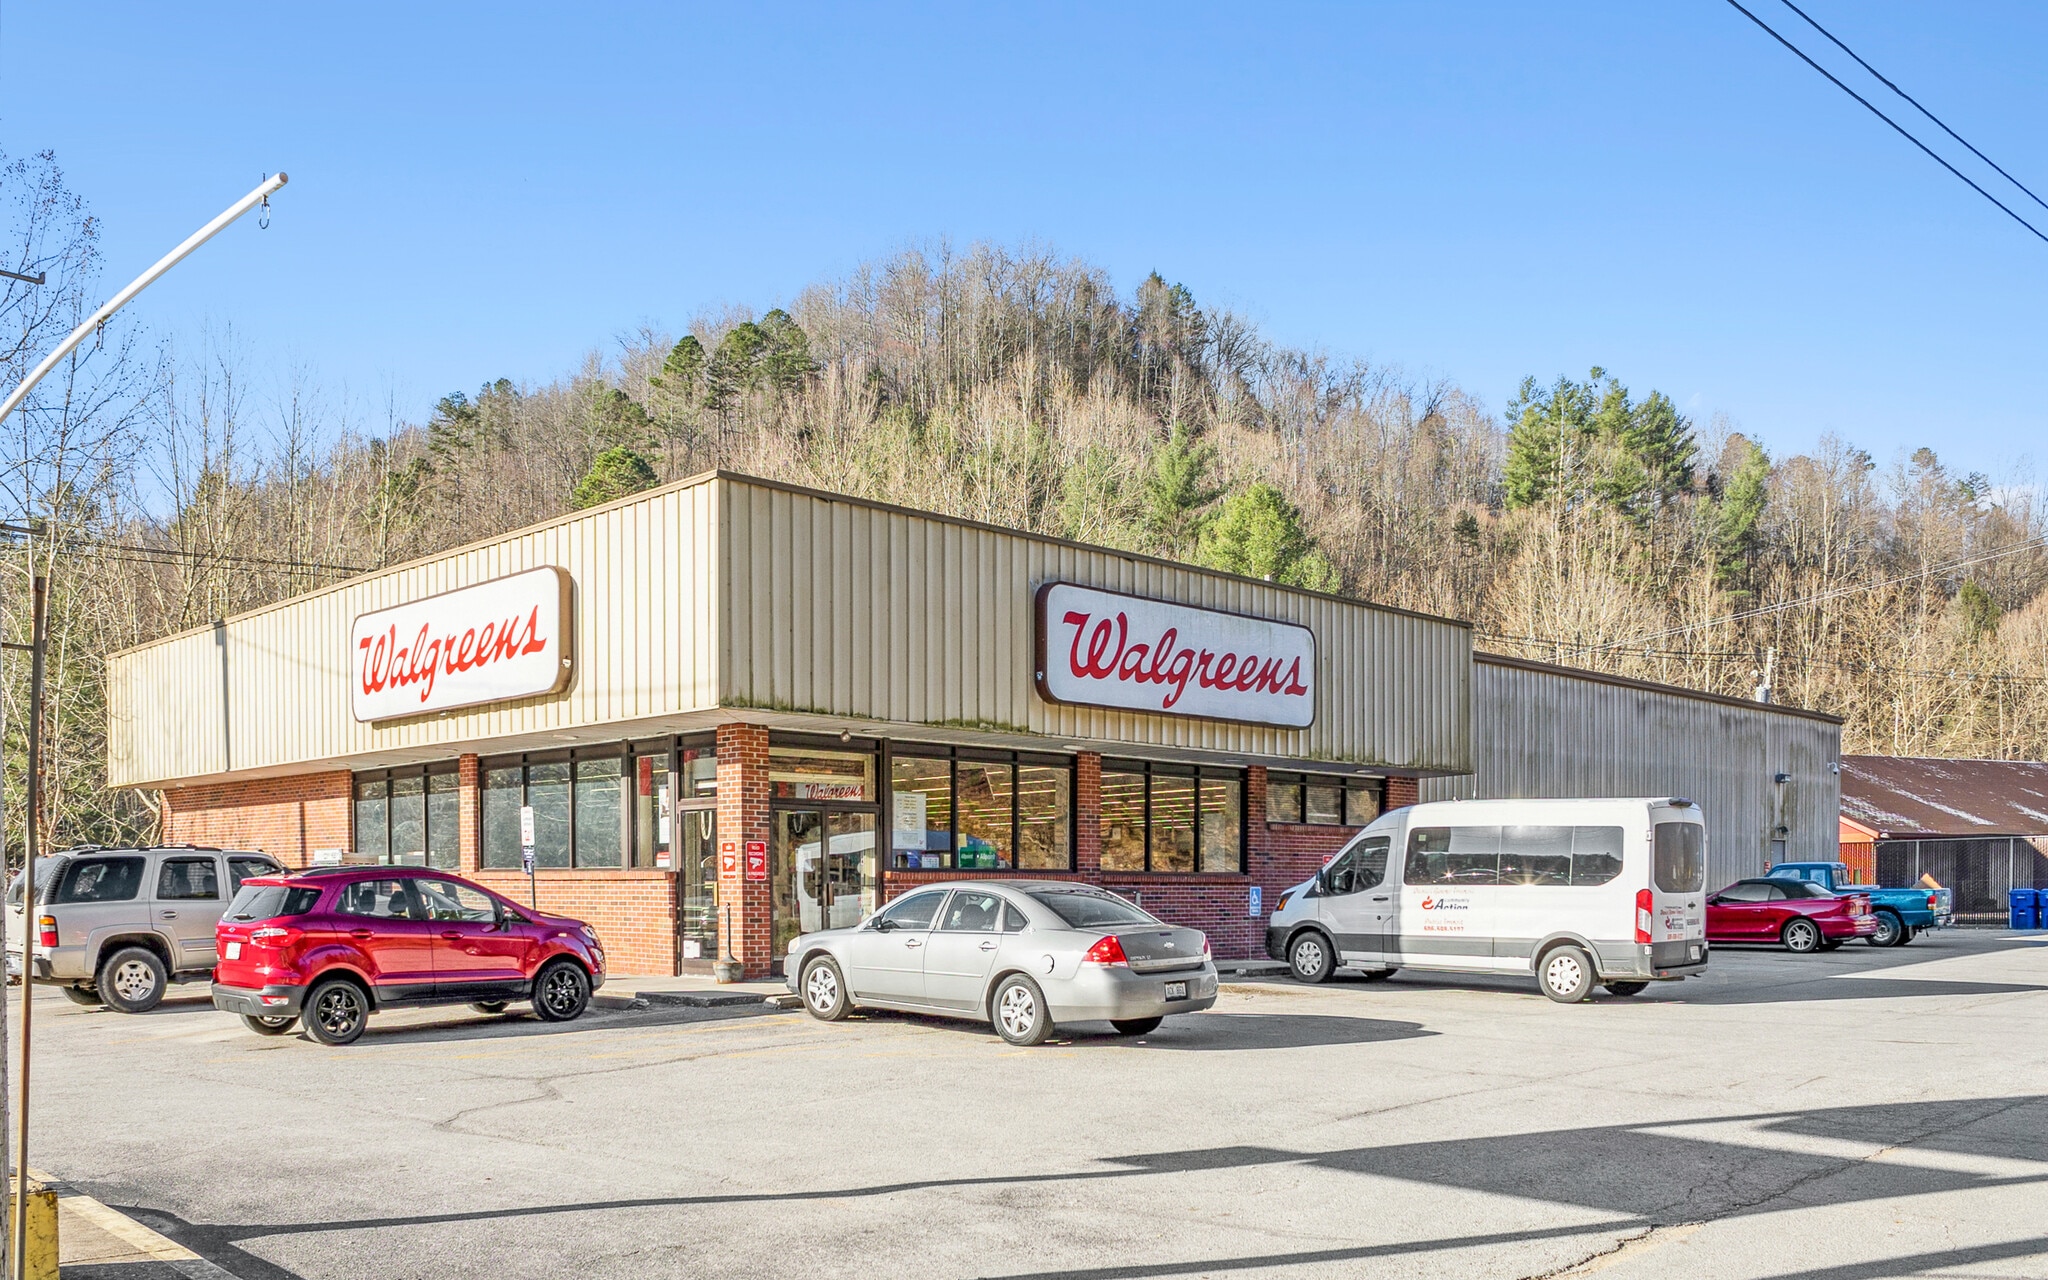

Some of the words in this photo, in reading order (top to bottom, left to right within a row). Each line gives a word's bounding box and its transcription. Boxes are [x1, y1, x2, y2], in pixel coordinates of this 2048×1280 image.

[359, 604, 547, 703] Walgreens
[1062, 610, 1308, 709] Walgreens
[805, 783, 865, 800] Walgreens
